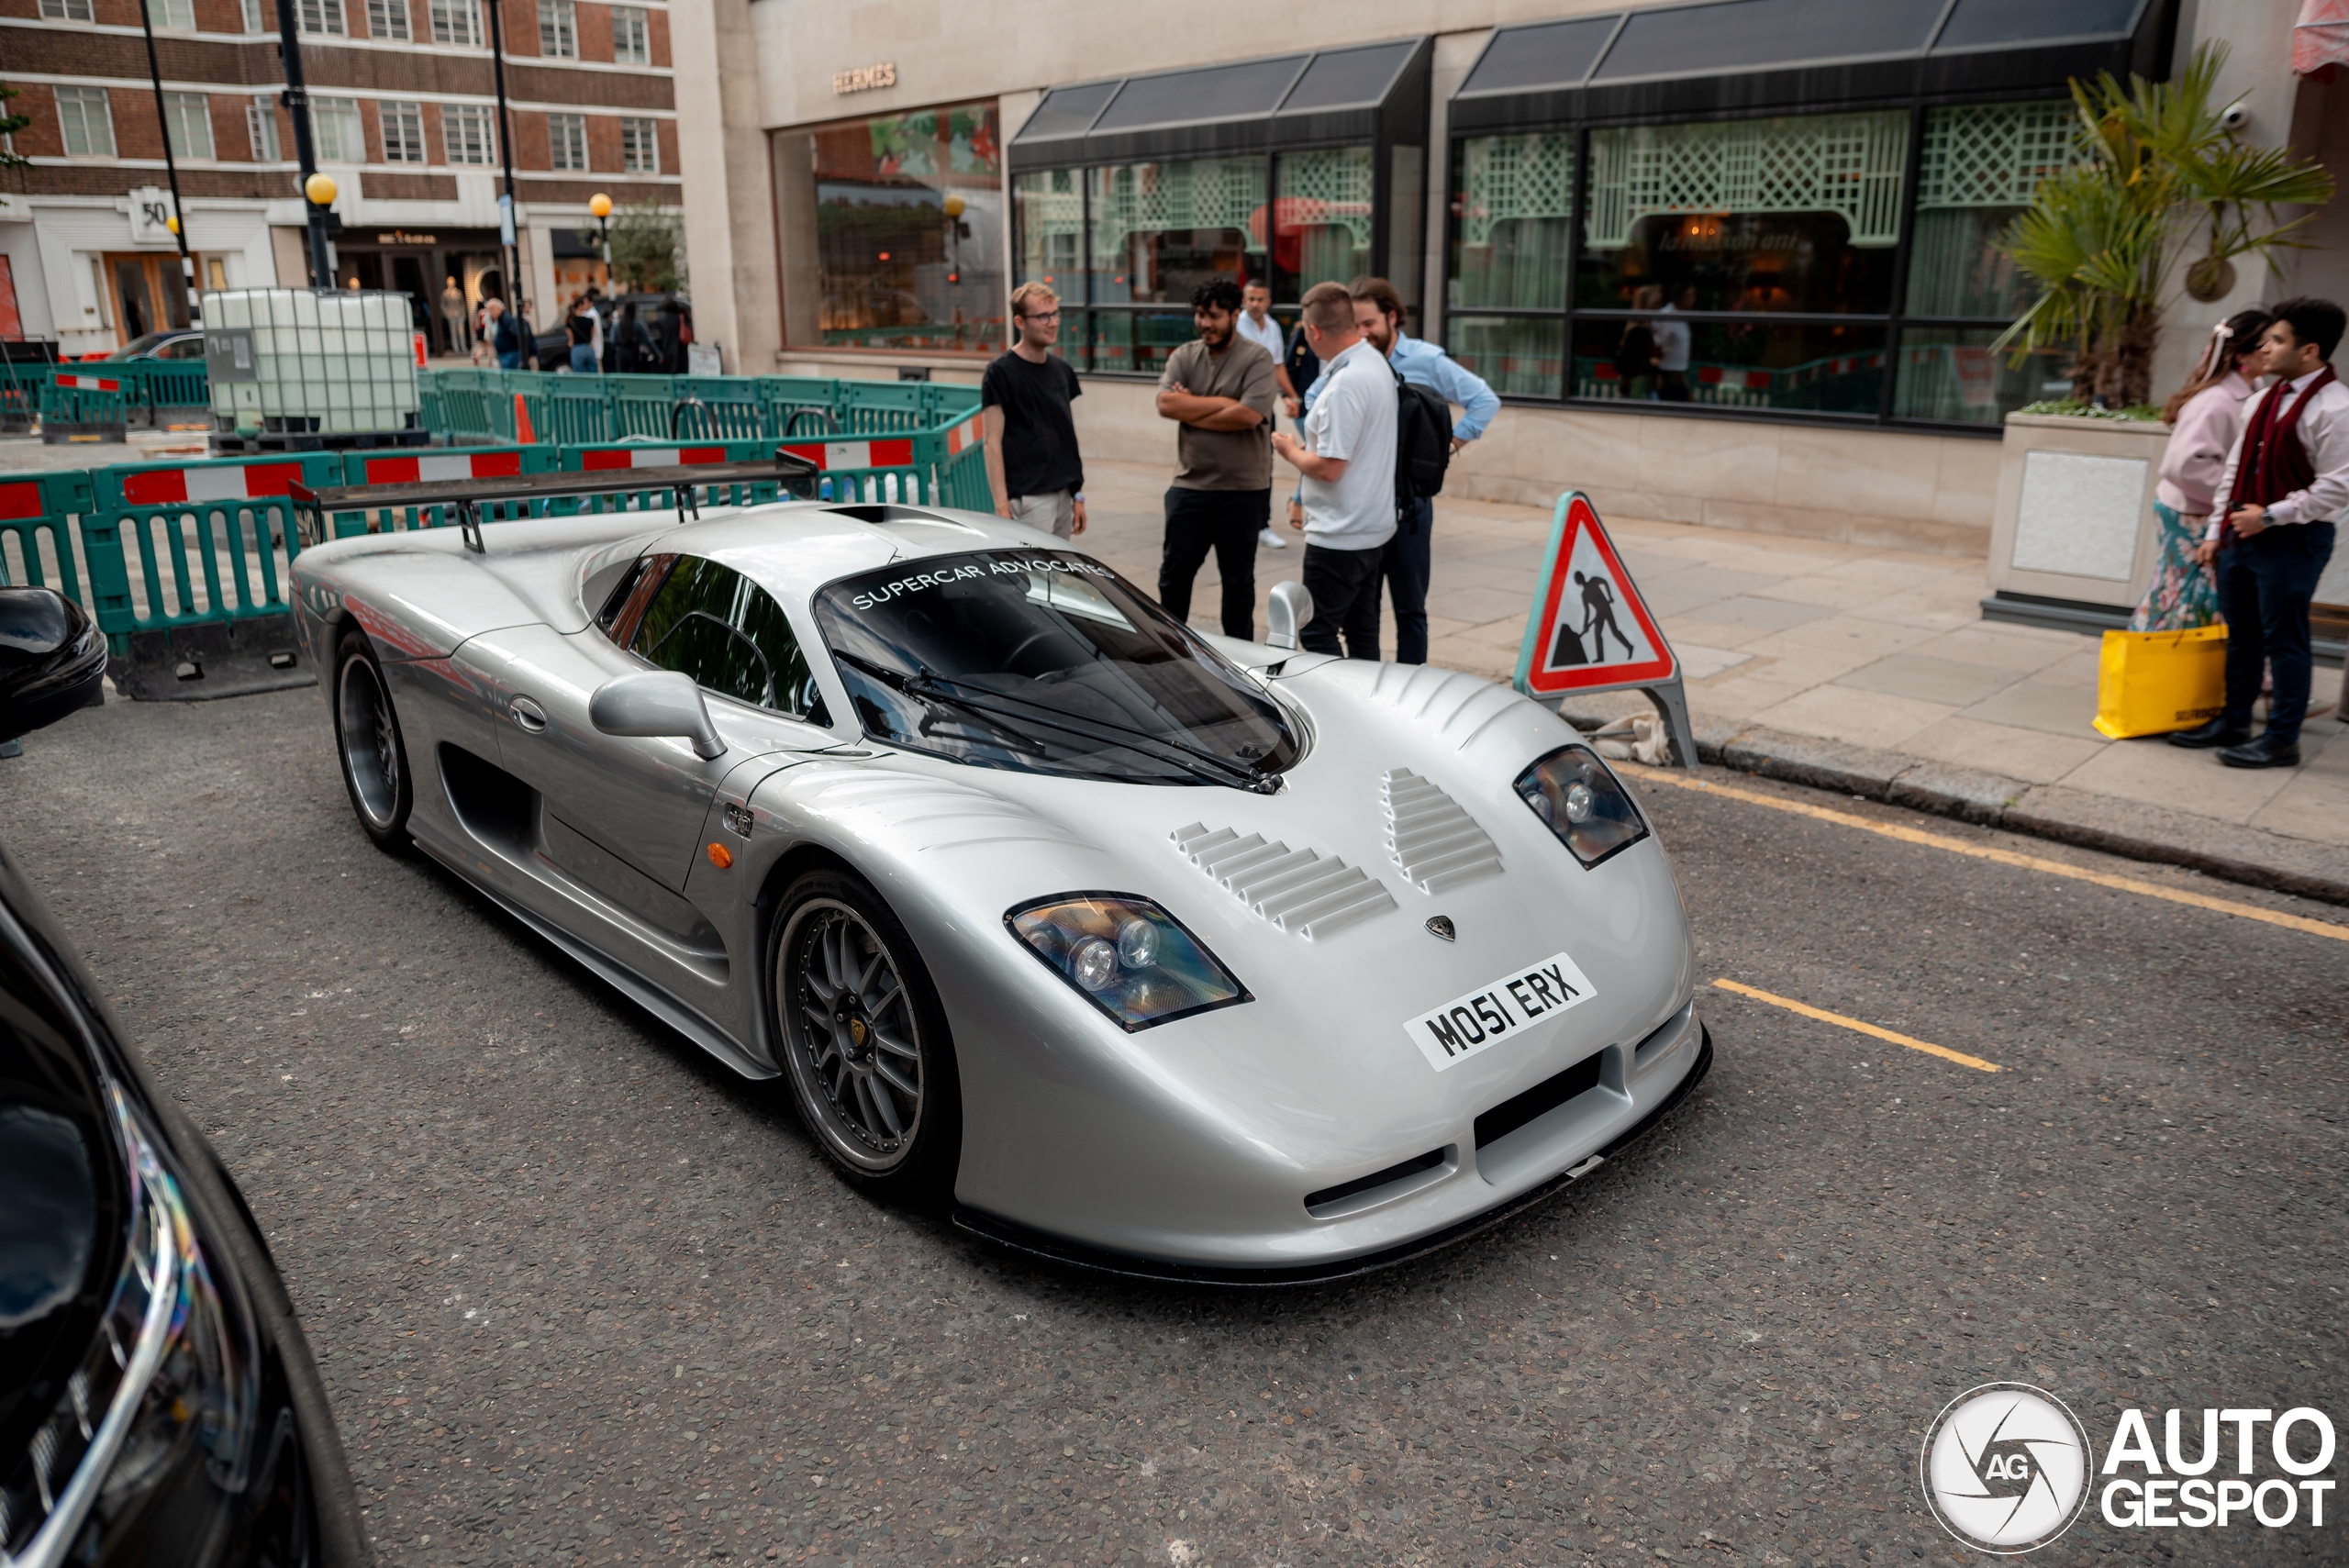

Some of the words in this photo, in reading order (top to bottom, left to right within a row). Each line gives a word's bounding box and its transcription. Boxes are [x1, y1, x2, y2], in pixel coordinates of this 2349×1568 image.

[142, 202, 167, 227] 50
[852, 565, 986, 611] SUPERCAR
[989, 560, 1115, 580] ADVOCATES
[1505, 963, 1580, 1018] ERX
